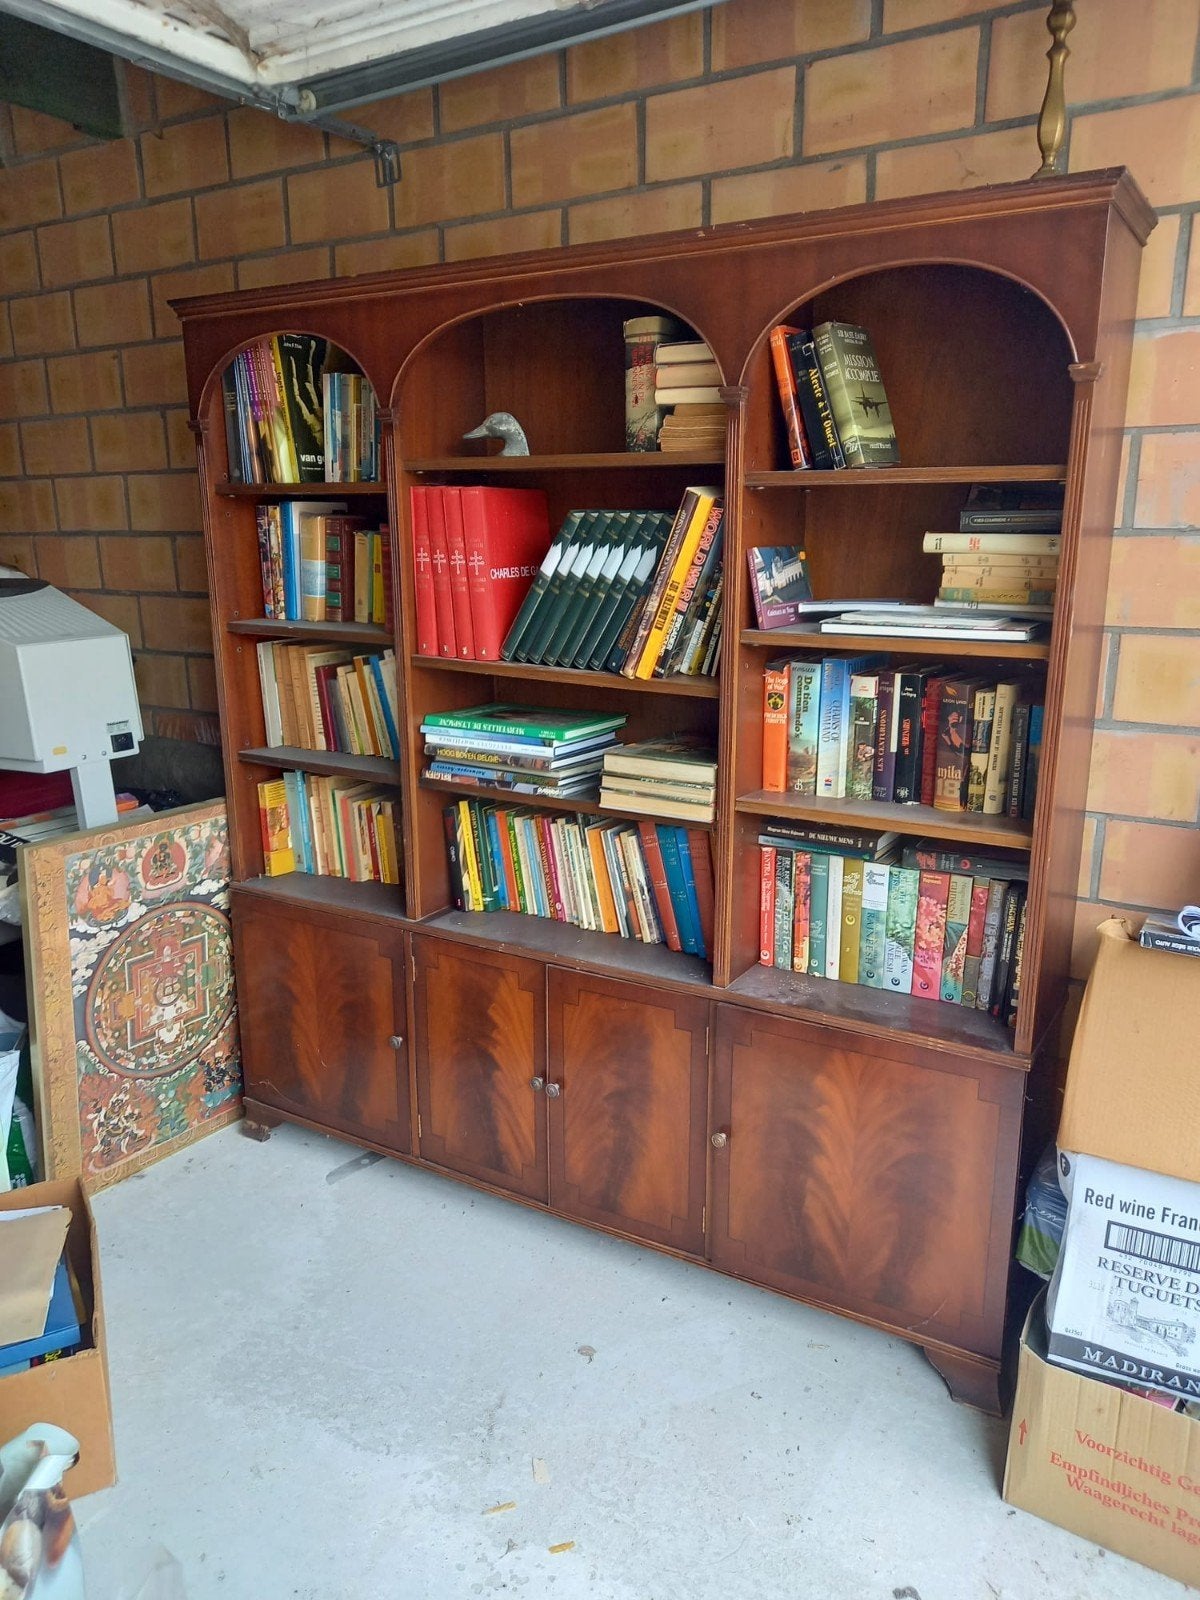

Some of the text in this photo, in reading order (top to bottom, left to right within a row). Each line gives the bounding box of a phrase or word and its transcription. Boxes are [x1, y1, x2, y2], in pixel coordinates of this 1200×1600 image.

[844, 354, 874, 367] MISSION
[845, 368, 880, 382] ACCOMPLIE
[808, 367, 823, 398] Alerte
[300, 454, 315, 462] van
[692, 505, 723, 566] WORLD
[490, 567, 520, 579] CHARLES
[521, 566, 529, 576] DE
[683, 564, 702, 602] WAR
[665, 613, 683, 650] BRIGADIER
[794, 675, 803, 737] commando's
[802, 675, 812, 712] De tien
[438, 718, 470, 728] L'ESPAGNE
[482, 723, 524, 734] MERVEILLES
[830, 699, 842, 742] CHAINS OF
[876, 709, 887, 755] CENTURIONS
[436, 748, 455, 758] HOOG
[455, 750, 476, 761] BOVEN
[937, 765, 961, 779] mila
[837, 836, 853, 845] MENS
[864, 912, 874, 964] RAJNEESH
[1085, 1188, 1200, 1231] Red wine Fran
[1097, 1256, 1181, 1290] RESERVE
[1083, 1347, 1200, 1393] MADIRAN
[1075, 1429, 1171, 1485] Voorzichtig
[1050, 1451, 1170, 1515] Empfindliches
[1066, 1474, 1166, 1529] Waagerecht
